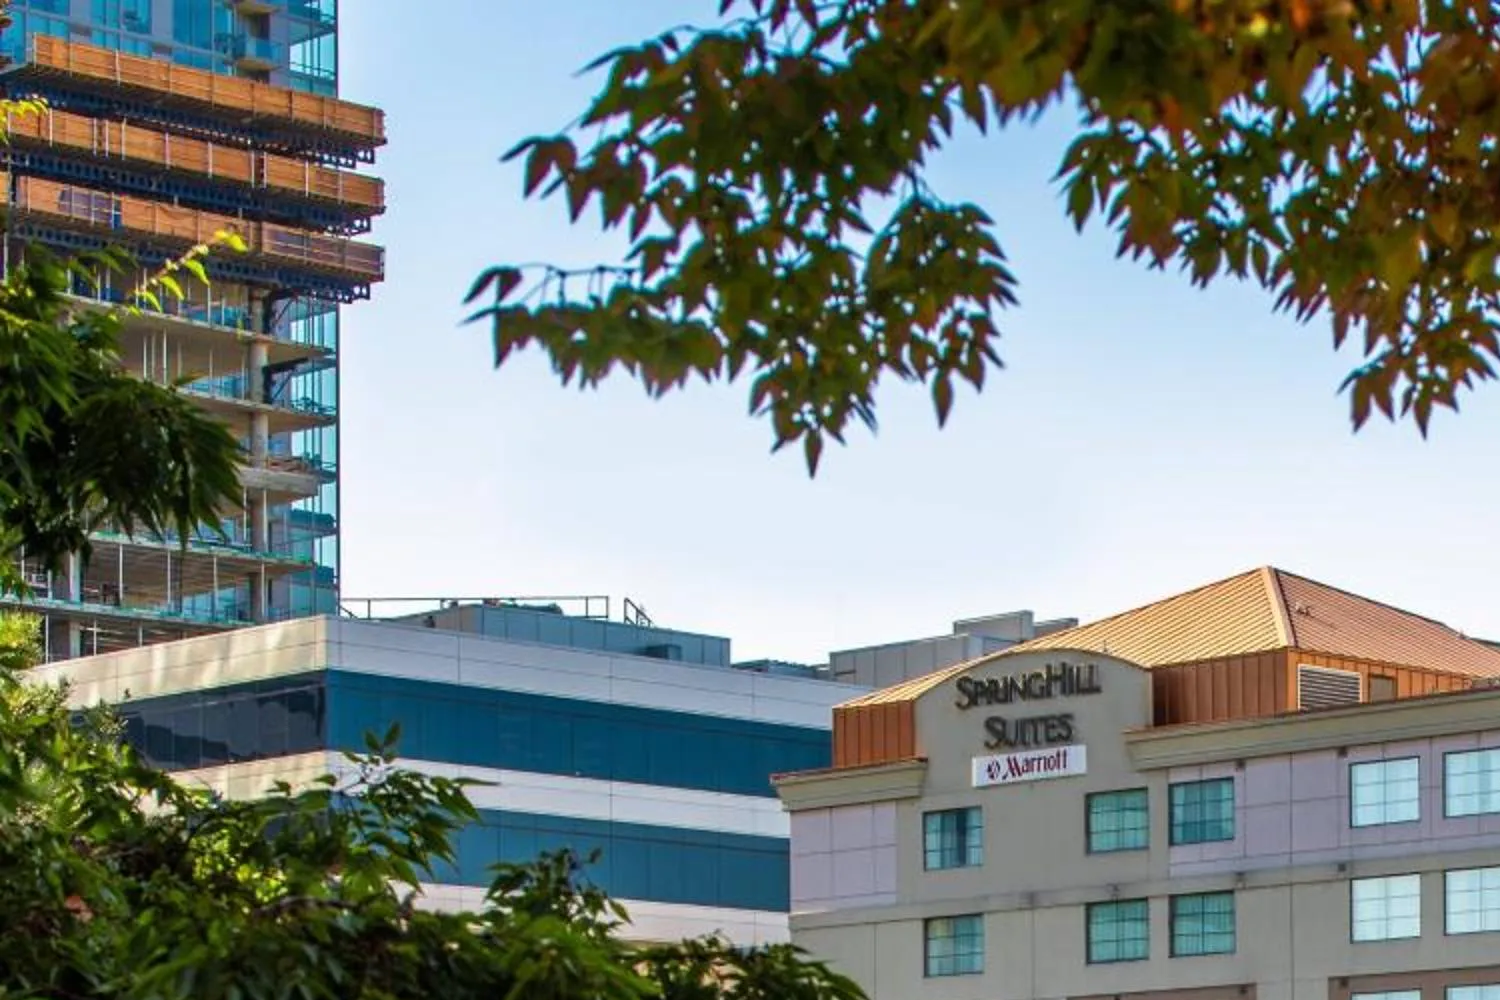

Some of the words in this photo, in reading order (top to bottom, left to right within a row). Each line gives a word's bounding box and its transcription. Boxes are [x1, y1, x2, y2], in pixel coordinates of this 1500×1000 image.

[954, 661, 1103, 711] SPRINGHILL
[983, 712, 1074, 749] SUITES
[1001, 748, 1067, 780] Marriott
